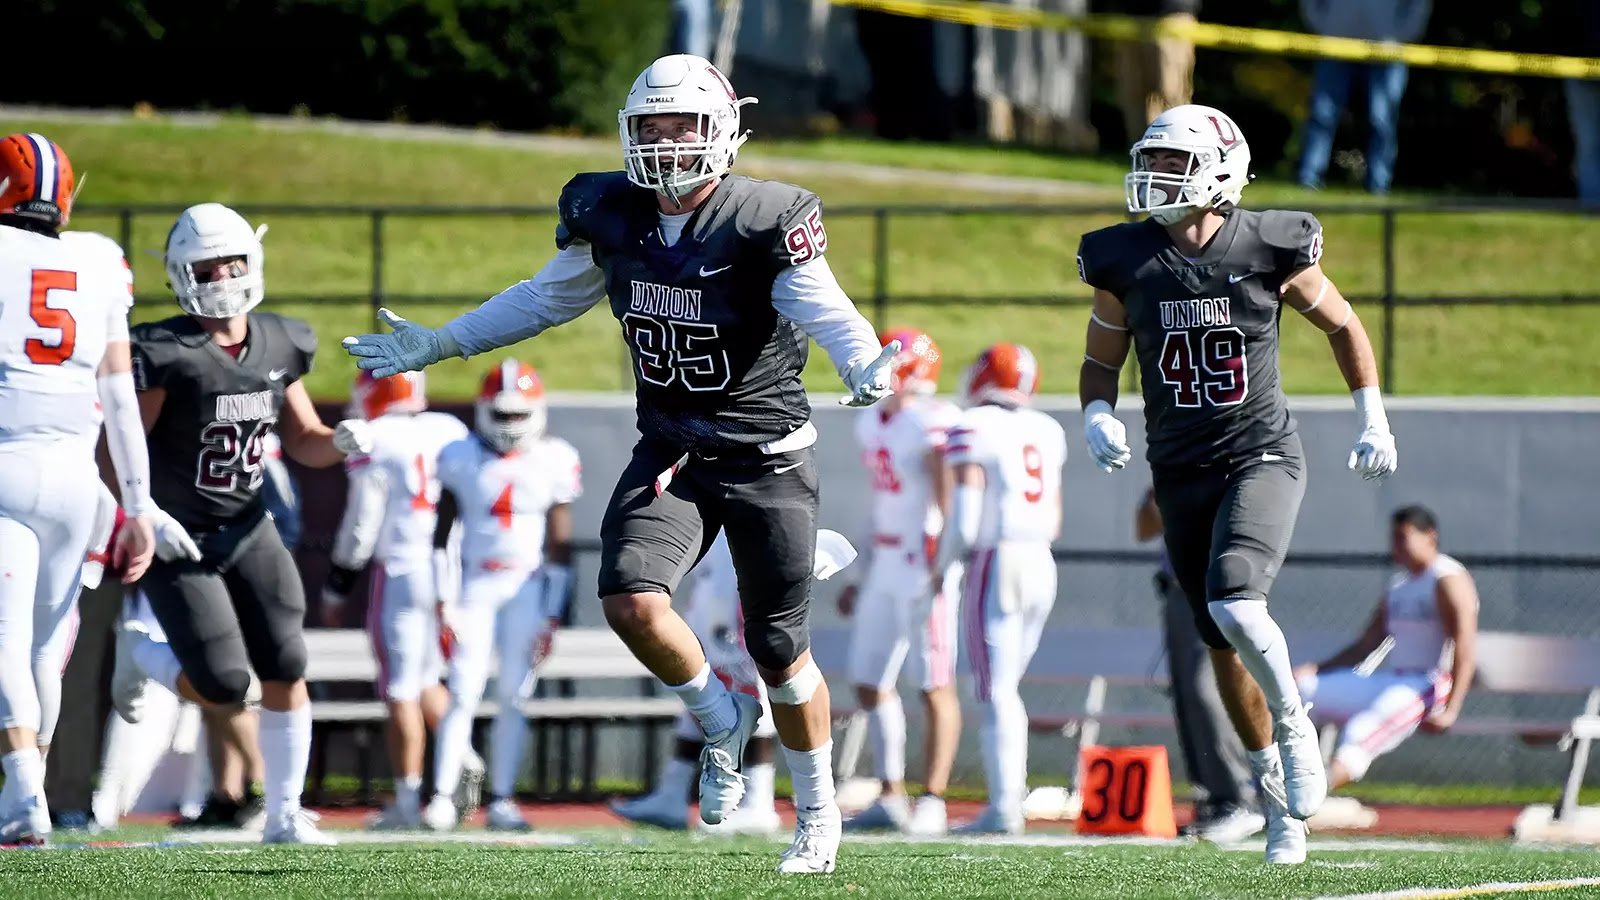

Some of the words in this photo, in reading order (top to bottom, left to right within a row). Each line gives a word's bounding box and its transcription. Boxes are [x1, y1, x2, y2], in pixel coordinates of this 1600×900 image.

[645, 96, 675, 104] FAMILY
[1206, 115, 1238, 147] U
[784, 205, 828, 266] 95
[24, 269, 77, 366] 5
[631, 280, 702, 321] UNION
[1159, 298, 1231, 329] UNION
[622, 312, 731, 392] 95
[1158, 326, 1249, 408] 49
[216, 390, 274, 422] UNION
[1022, 444, 1044, 503] 9
[489, 481, 515, 529] 4
[1083, 758, 1147, 822] 30
